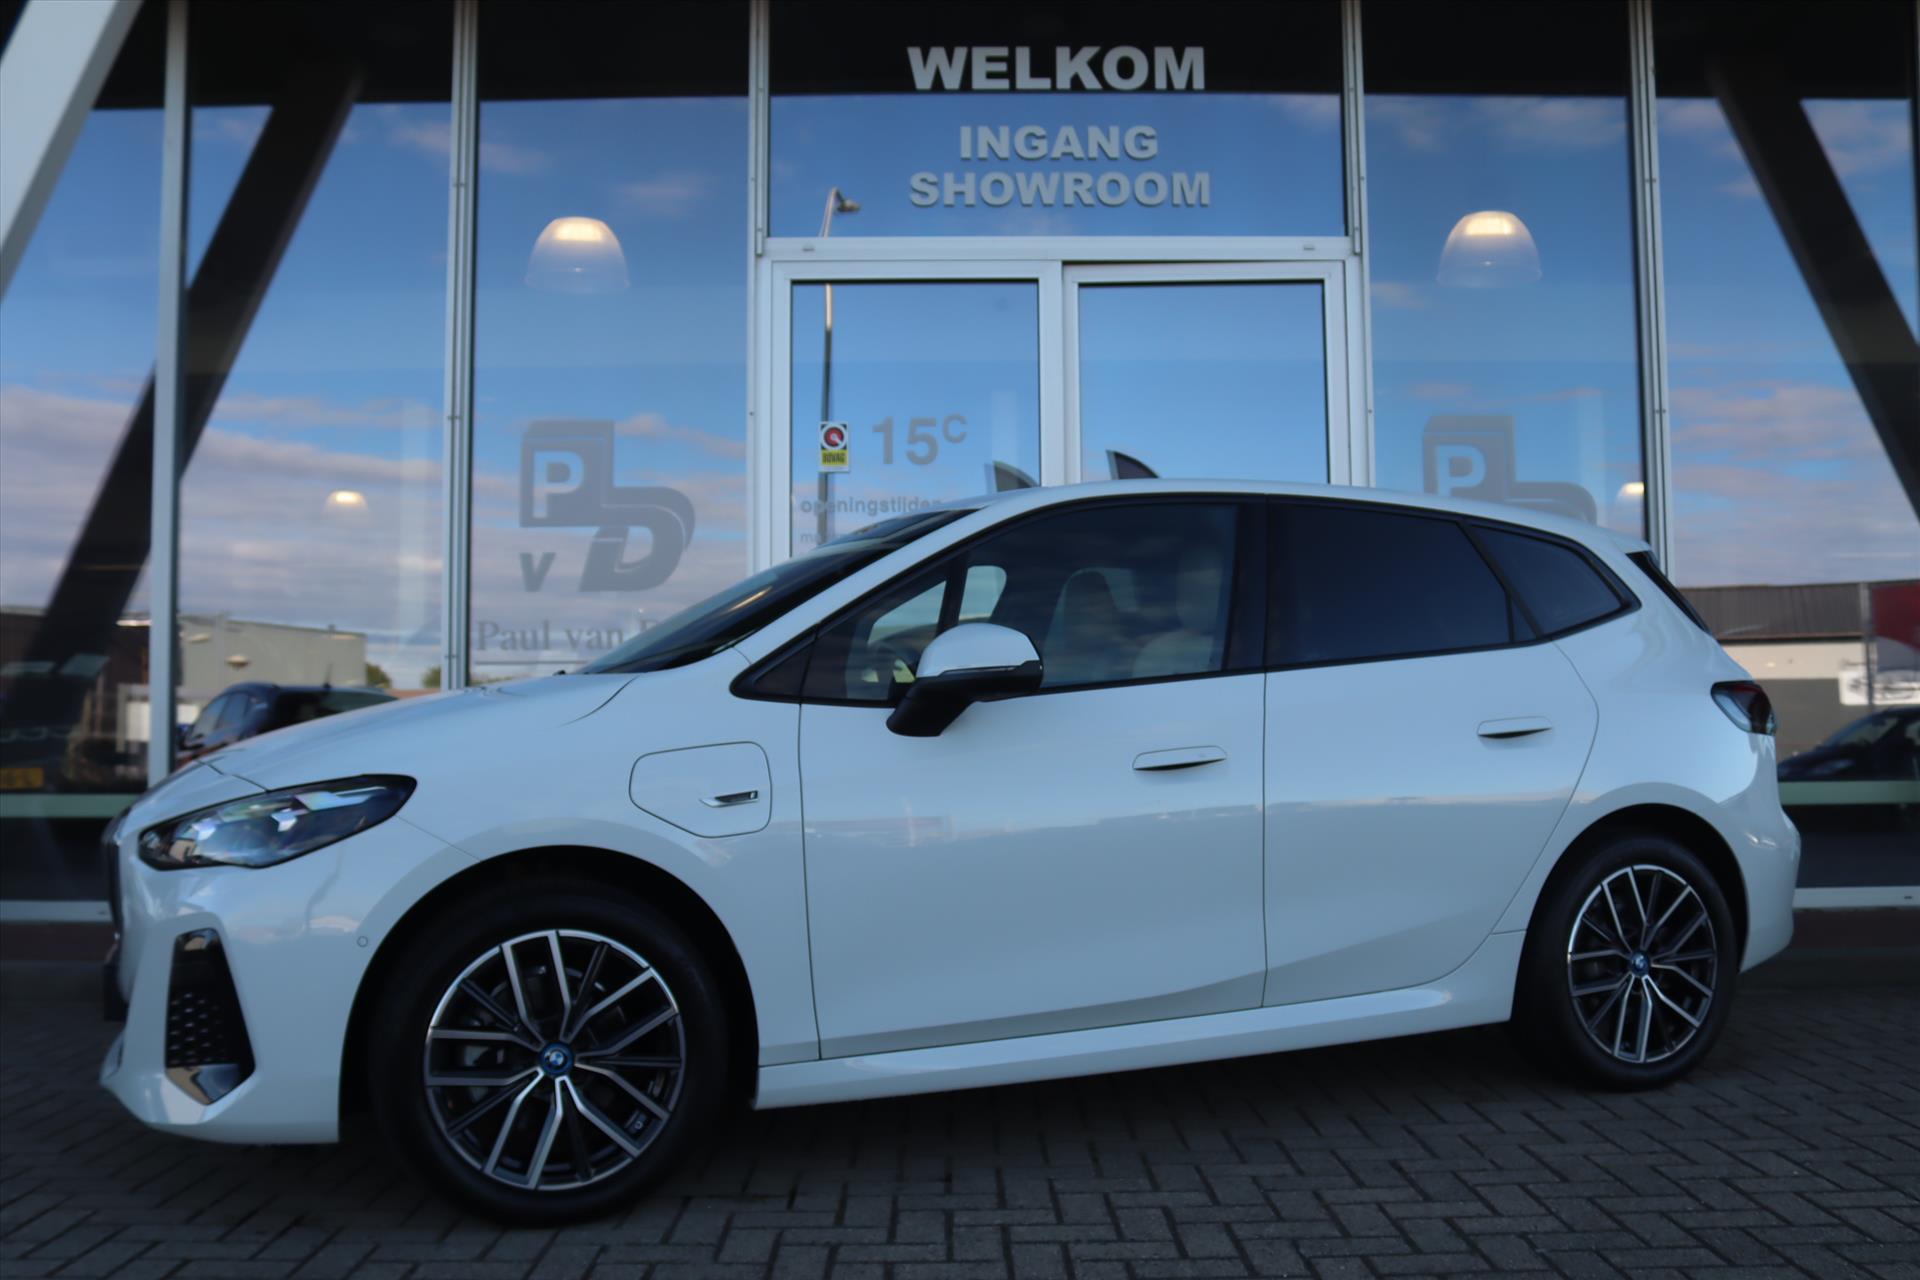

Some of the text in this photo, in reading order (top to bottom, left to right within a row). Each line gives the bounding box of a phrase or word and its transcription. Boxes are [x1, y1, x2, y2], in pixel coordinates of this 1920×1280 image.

[906, 46, 1206, 90] WELKOM
[959, 125, 1159, 160] INGANG
[909, 171, 1211, 207] SHOWROOM
[476, 620, 550, 650] Paul
[565, 625, 624, 650] van
